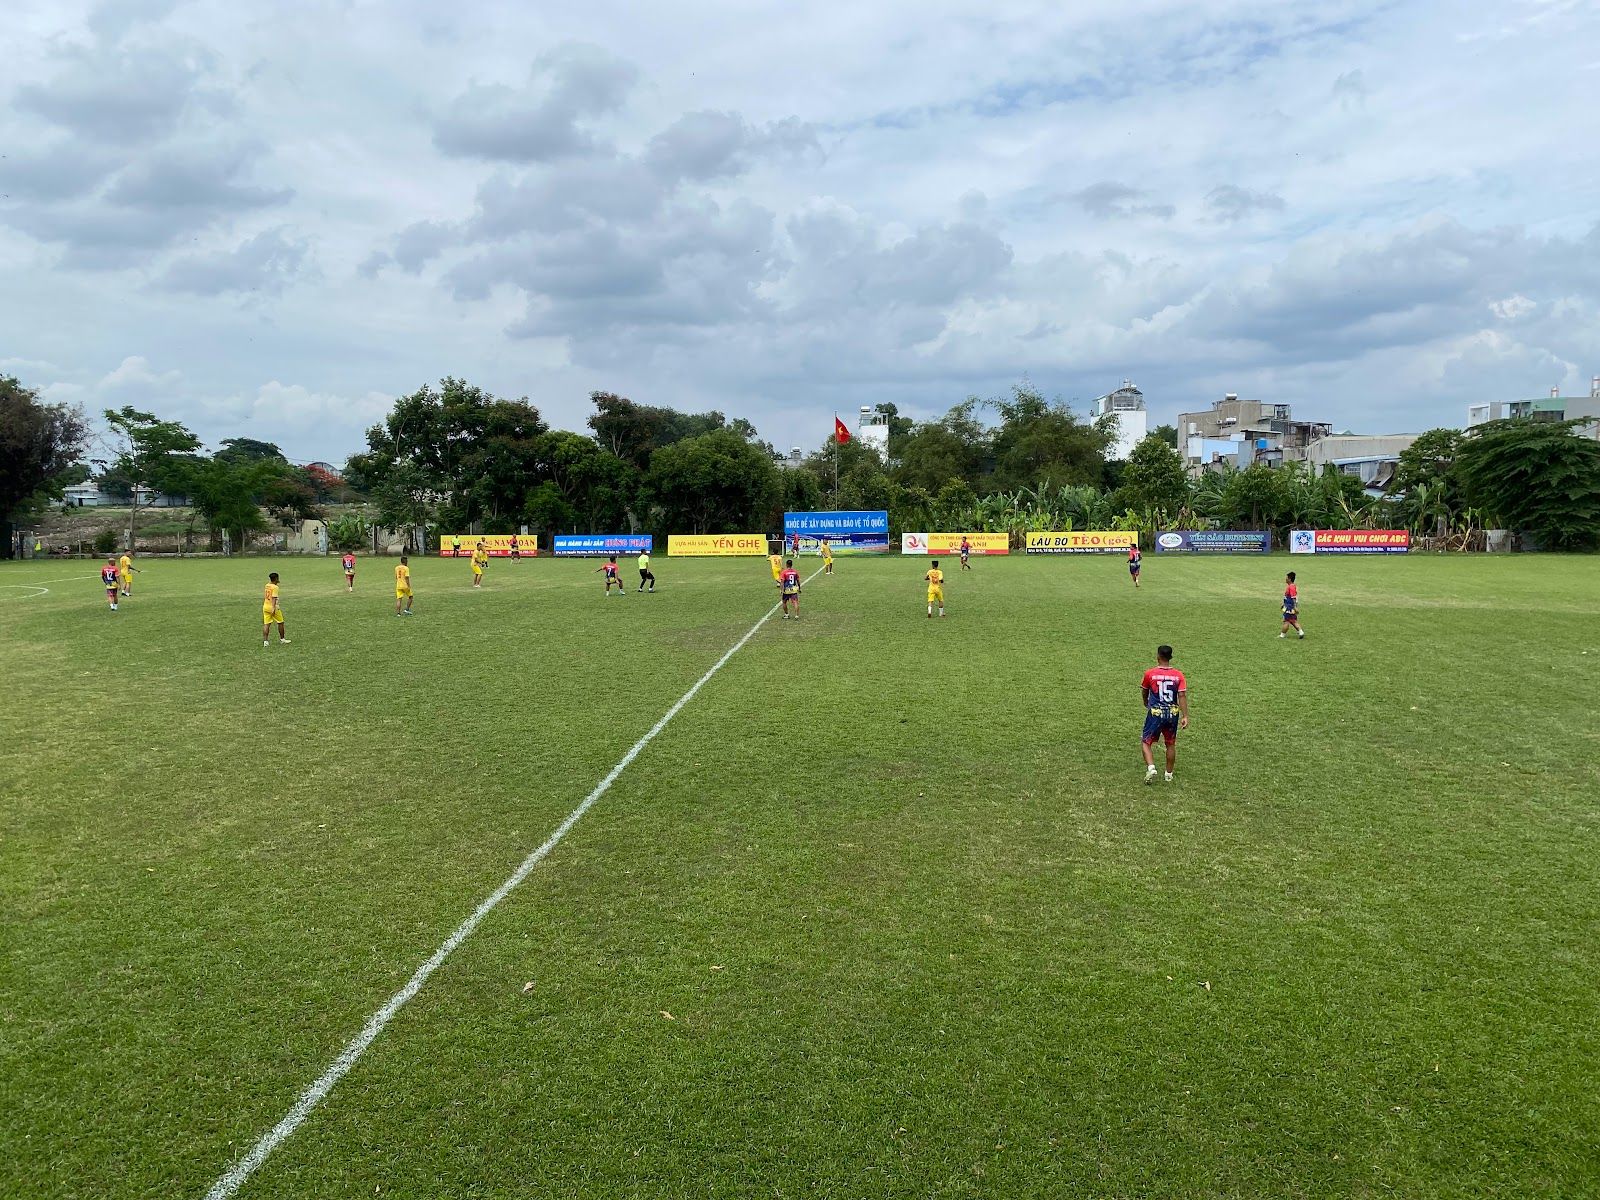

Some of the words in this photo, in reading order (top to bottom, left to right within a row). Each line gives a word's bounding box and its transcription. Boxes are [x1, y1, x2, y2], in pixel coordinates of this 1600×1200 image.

[809, 518, 819, 528] XÂY
[834, 517, 842, 528] VÀ
[843, 517, 854, 528] BẢO
[871, 516, 885, 528] QUỐC
[712, 536, 734, 548] YẾN
[737, 539, 760, 550] GHẸ
[1103, 534, 1133, 545] (gốc)
[1317, 533, 1332, 543] CÁC
[1334, 534, 1351, 543] KHU
[1353, 534, 1367, 543] VUI
[1369, 534, 1388, 543] CHƠI
[1389, 534, 1406, 543] ABC
[106, 570, 114, 581] 12
[607, 567, 612, 577] 7
[788, 574, 795, 585] 9
[1157, 680, 1174, 702] 15
